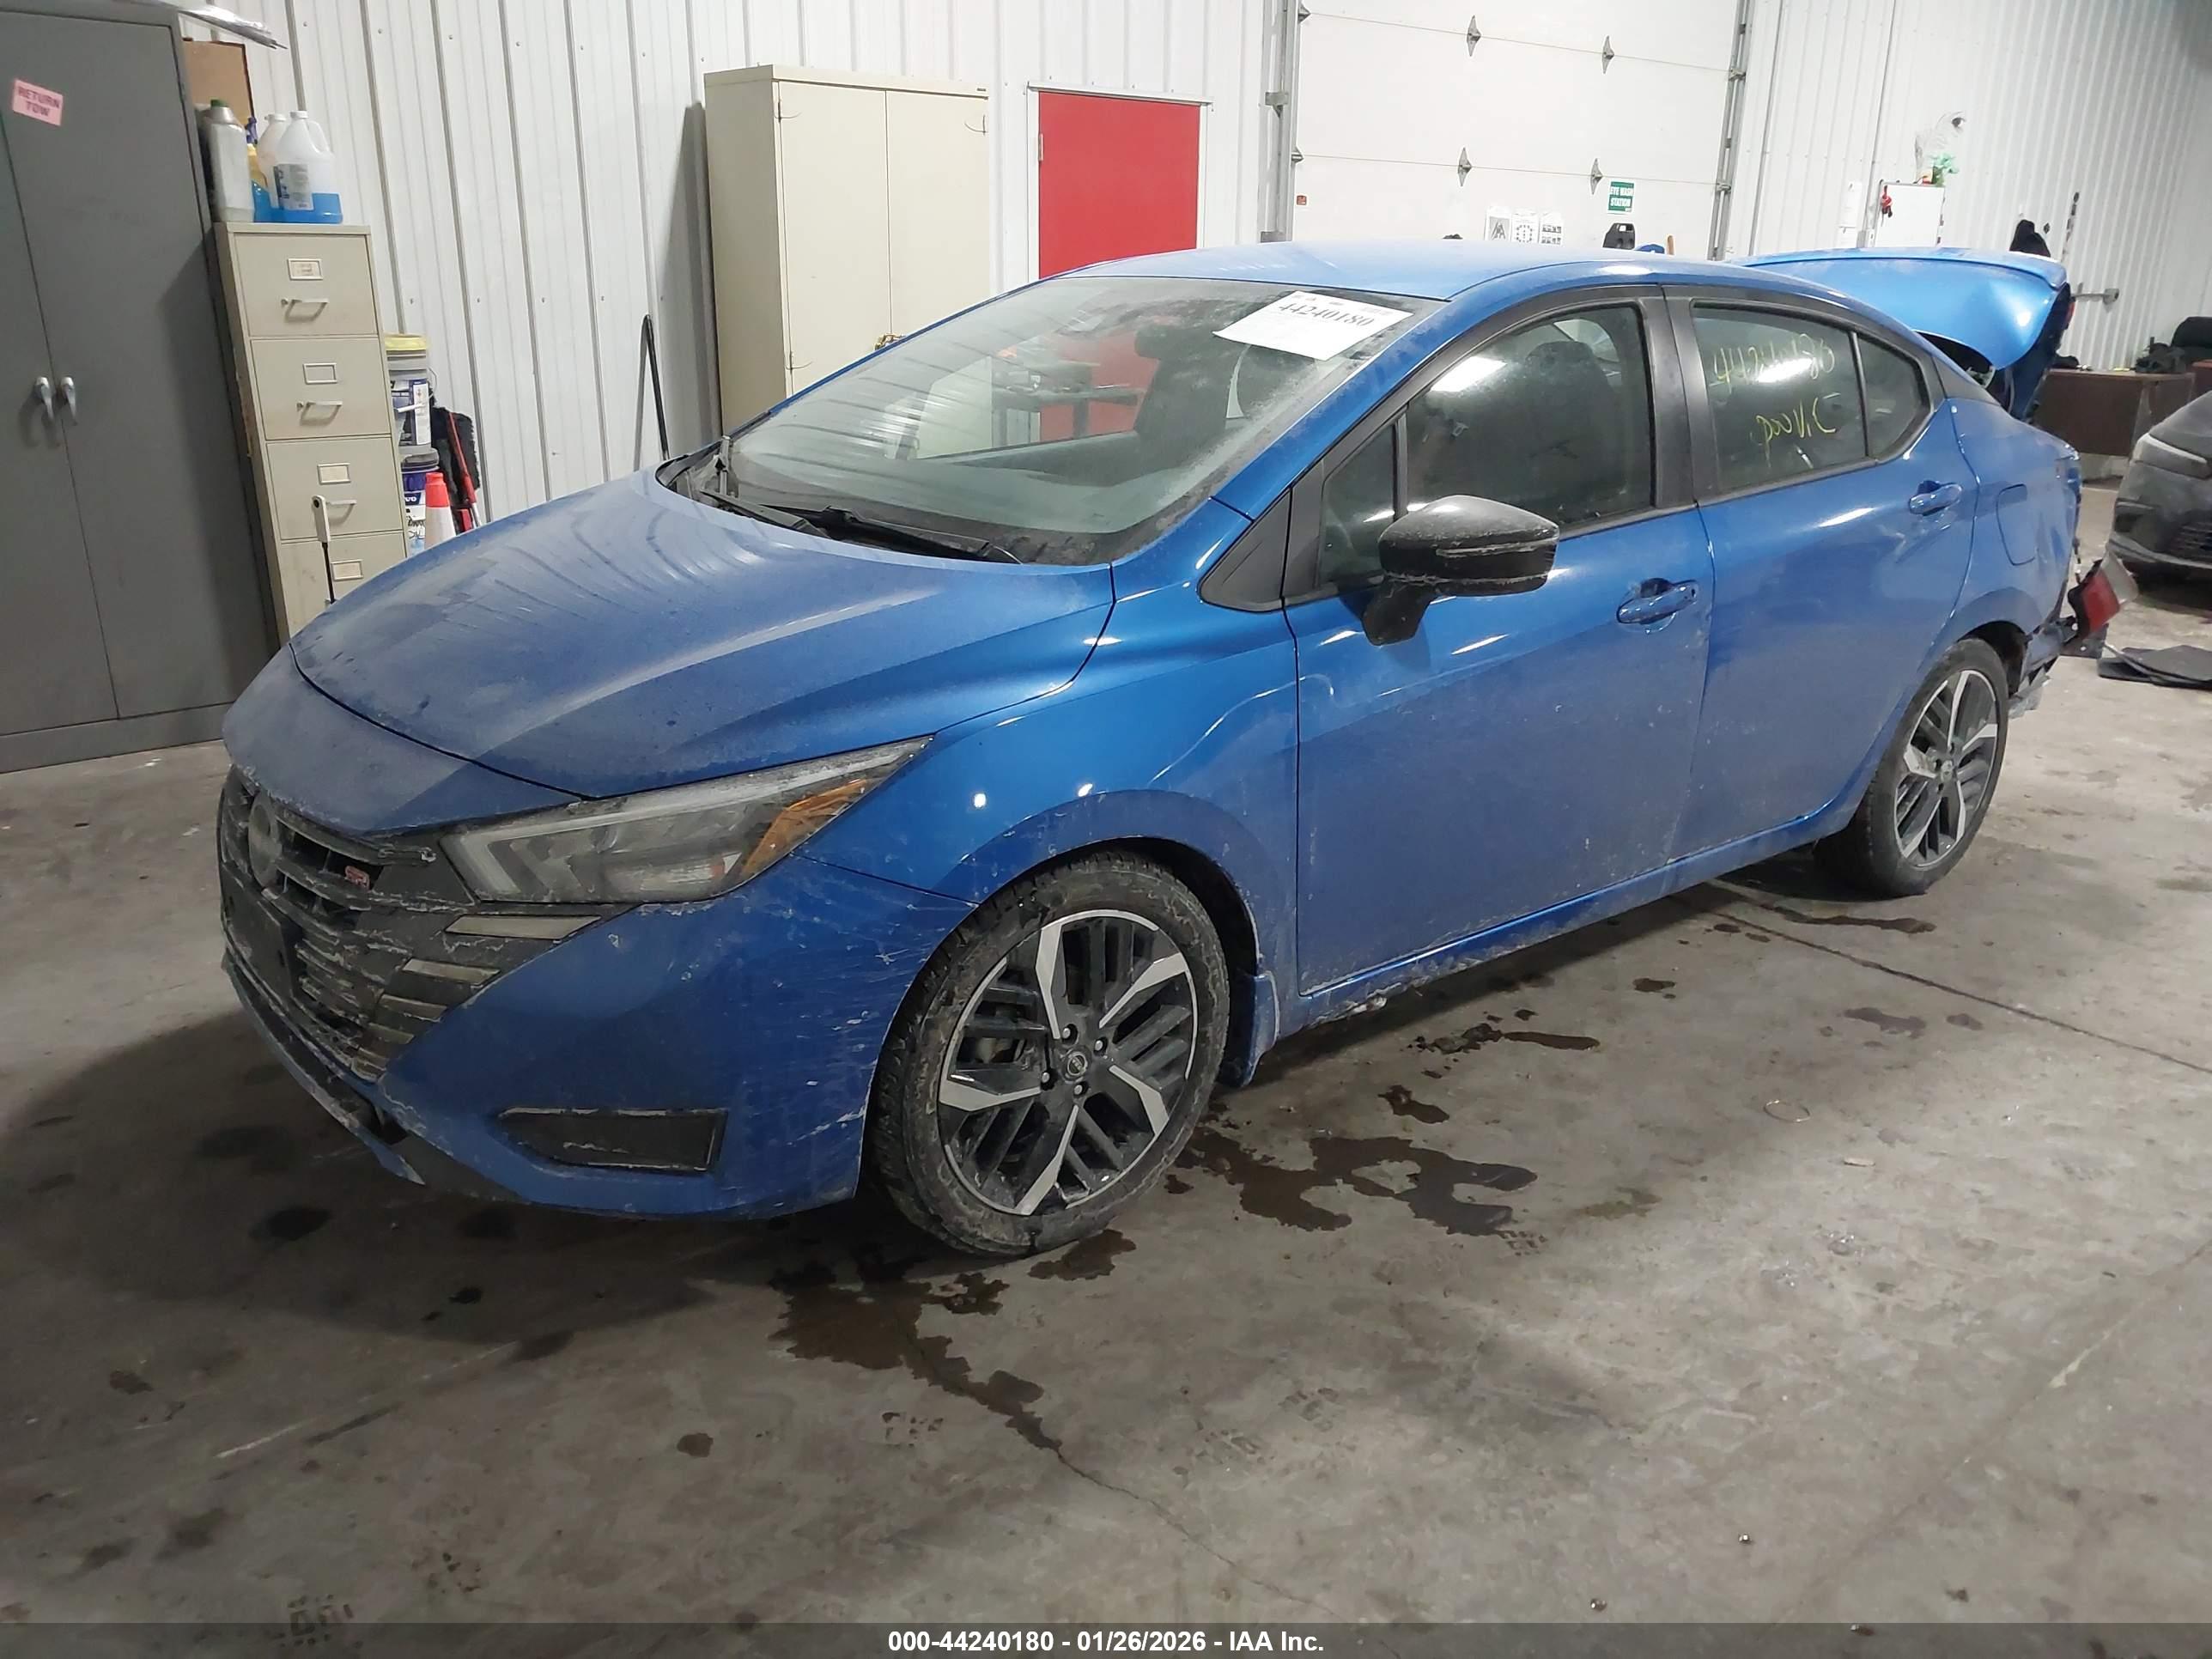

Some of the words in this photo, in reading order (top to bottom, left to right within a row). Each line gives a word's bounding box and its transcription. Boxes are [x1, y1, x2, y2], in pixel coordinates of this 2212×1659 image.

[18, 86, 60, 109] RETURN
[26, 100, 50, 117] TOW
[1278, 303, 1375, 326] 44240180
[1712, 332, 1835, 392] 4424180
